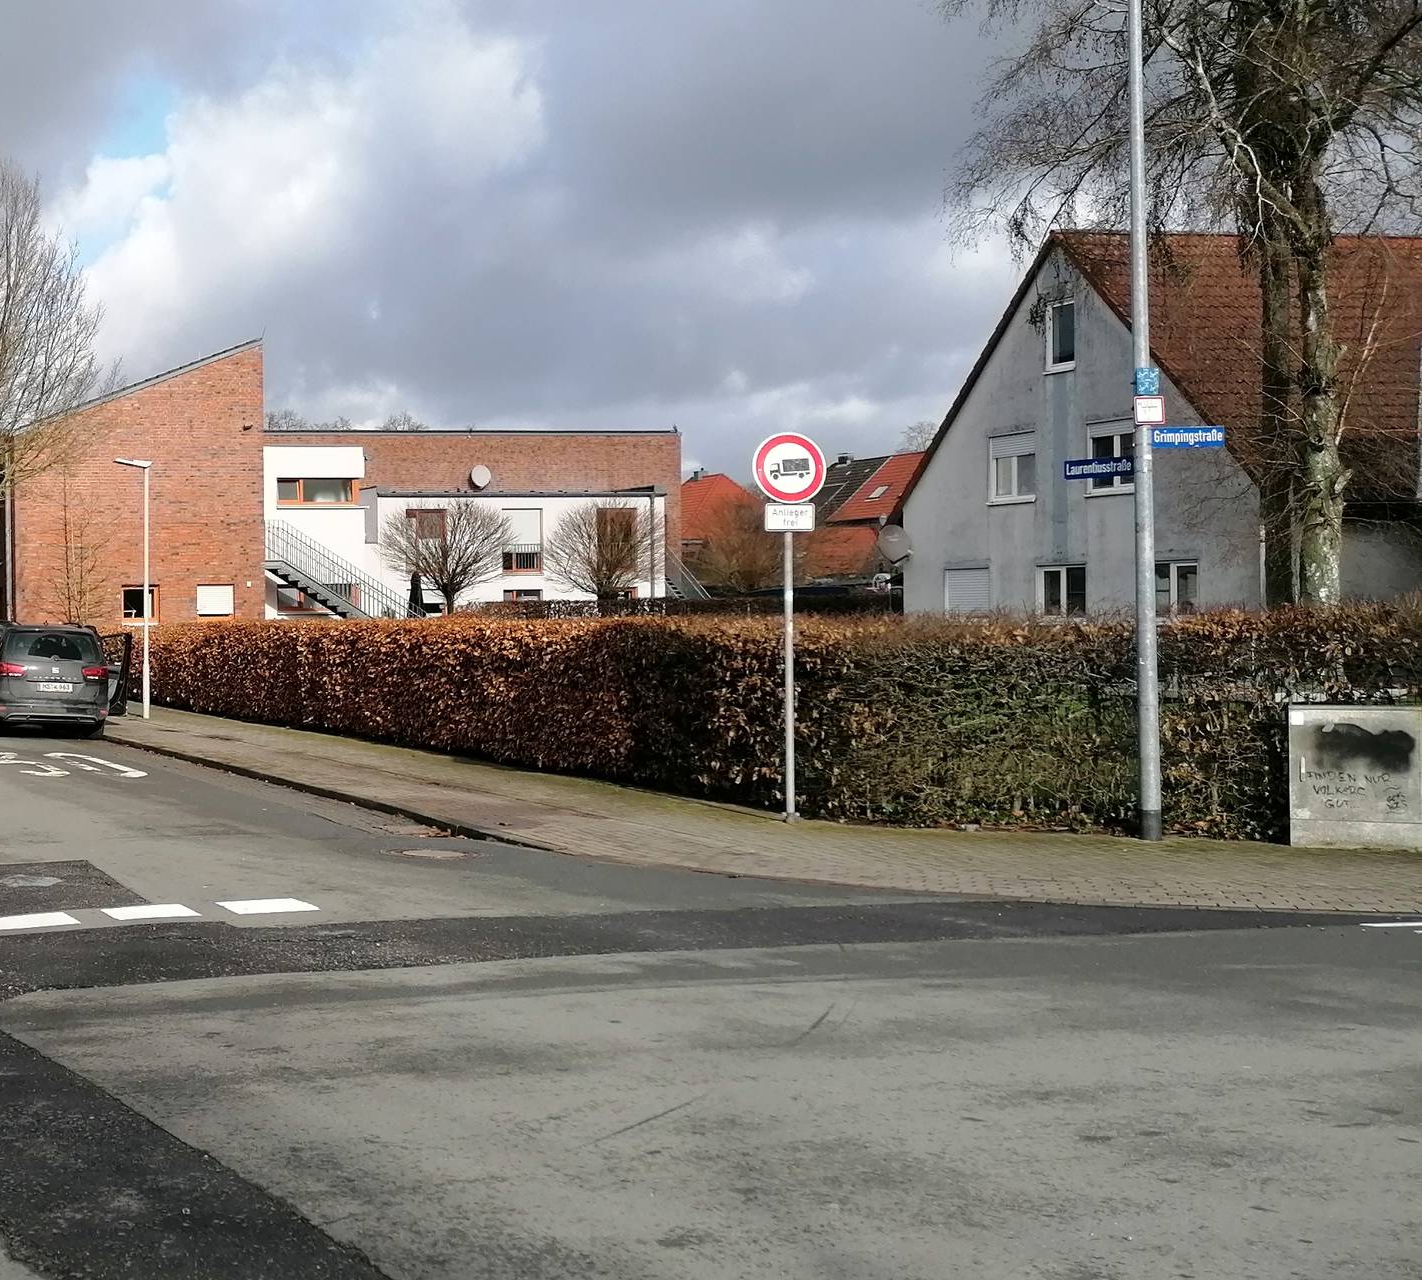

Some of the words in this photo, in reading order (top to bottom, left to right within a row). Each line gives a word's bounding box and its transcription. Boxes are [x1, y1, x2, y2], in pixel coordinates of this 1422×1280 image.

[1153, 428, 1223, 446] Grimpingstraße
[1065, 459, 1132, 476] Laurentiusstraße
[772, 508, 809, 518] Anlieger
[783, 518, 799, 527] frei
